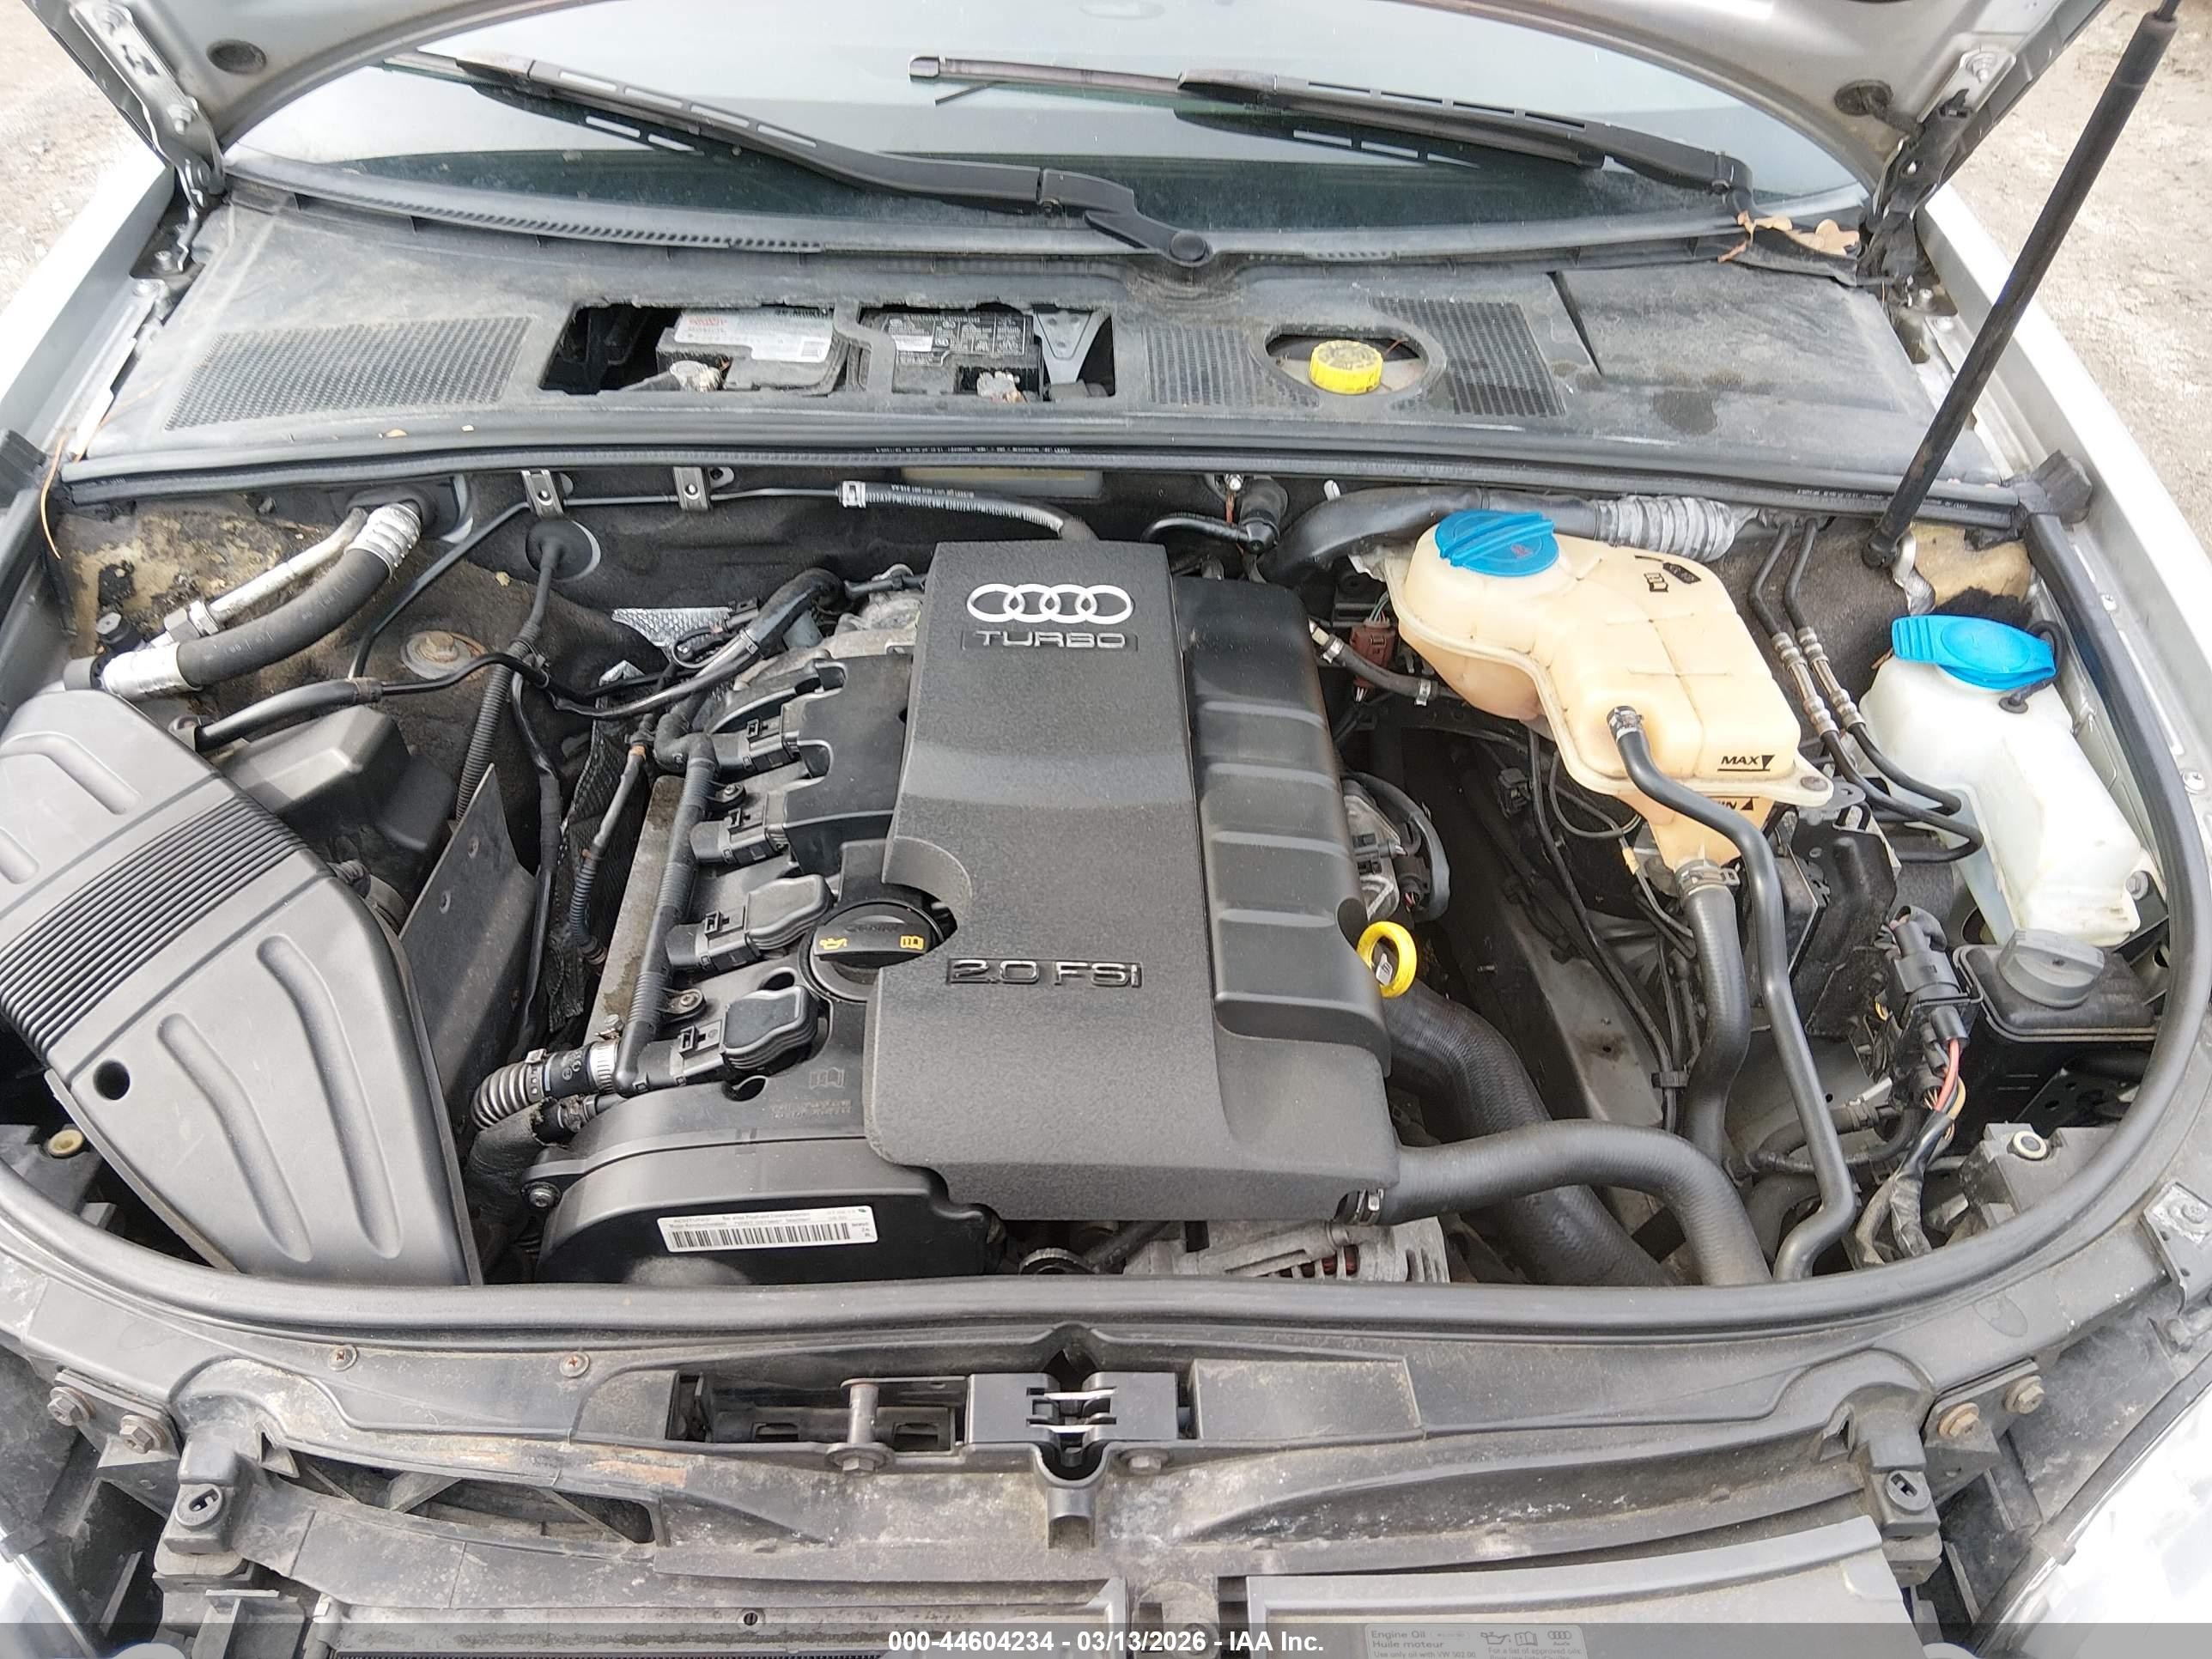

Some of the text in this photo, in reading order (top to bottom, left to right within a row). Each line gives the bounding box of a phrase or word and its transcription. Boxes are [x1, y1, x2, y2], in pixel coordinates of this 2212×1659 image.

[975, 630, 1126, 648] TURBO
[1721, 755, 1759, 765] MAX
[952, 958, 1142, 988] 2.0 FSI
[1370, 1630, 1407, 1640] Engine
[1411, 1630, 1425, 1638] Oil
[1390, 1650, 1406, 1659] only
